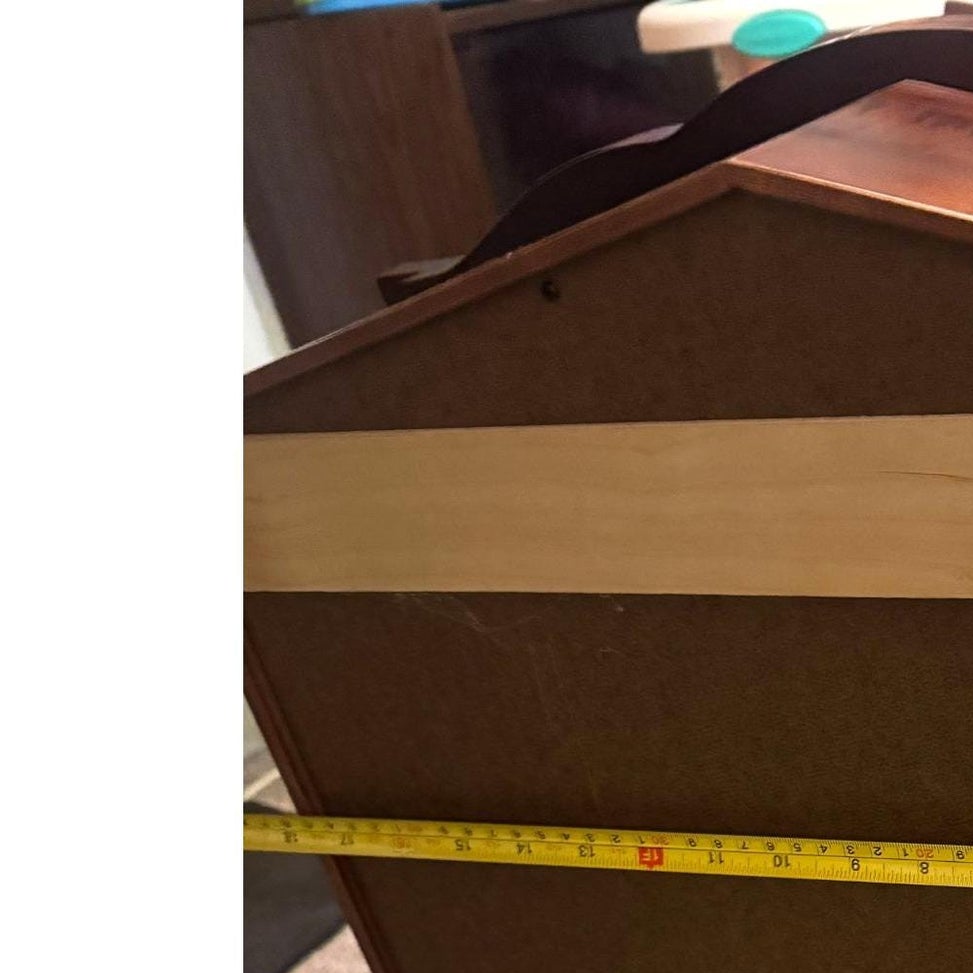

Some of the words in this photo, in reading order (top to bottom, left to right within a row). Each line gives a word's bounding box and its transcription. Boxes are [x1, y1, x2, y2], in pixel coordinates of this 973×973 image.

[610, 834, 621, 844] 2
[455, 839, 471, 851] 15
[517, 841, 533, 855] 14
[741, 841, 749, 849] 7
[793, 843, 802, 852] 5
[819, 844, 828, 853] 4
[846, 845, 855, 855] 3
[578, 844, 596, 858] 13
[873, 846, 882, 856] 2
[915, 848, 934, 859] 20
[709, 851, 725, 864] 11
[774, 854, 790, 868] 10
[851, 858, 861, 872] 9
[920, 862, 930, 875] 8
